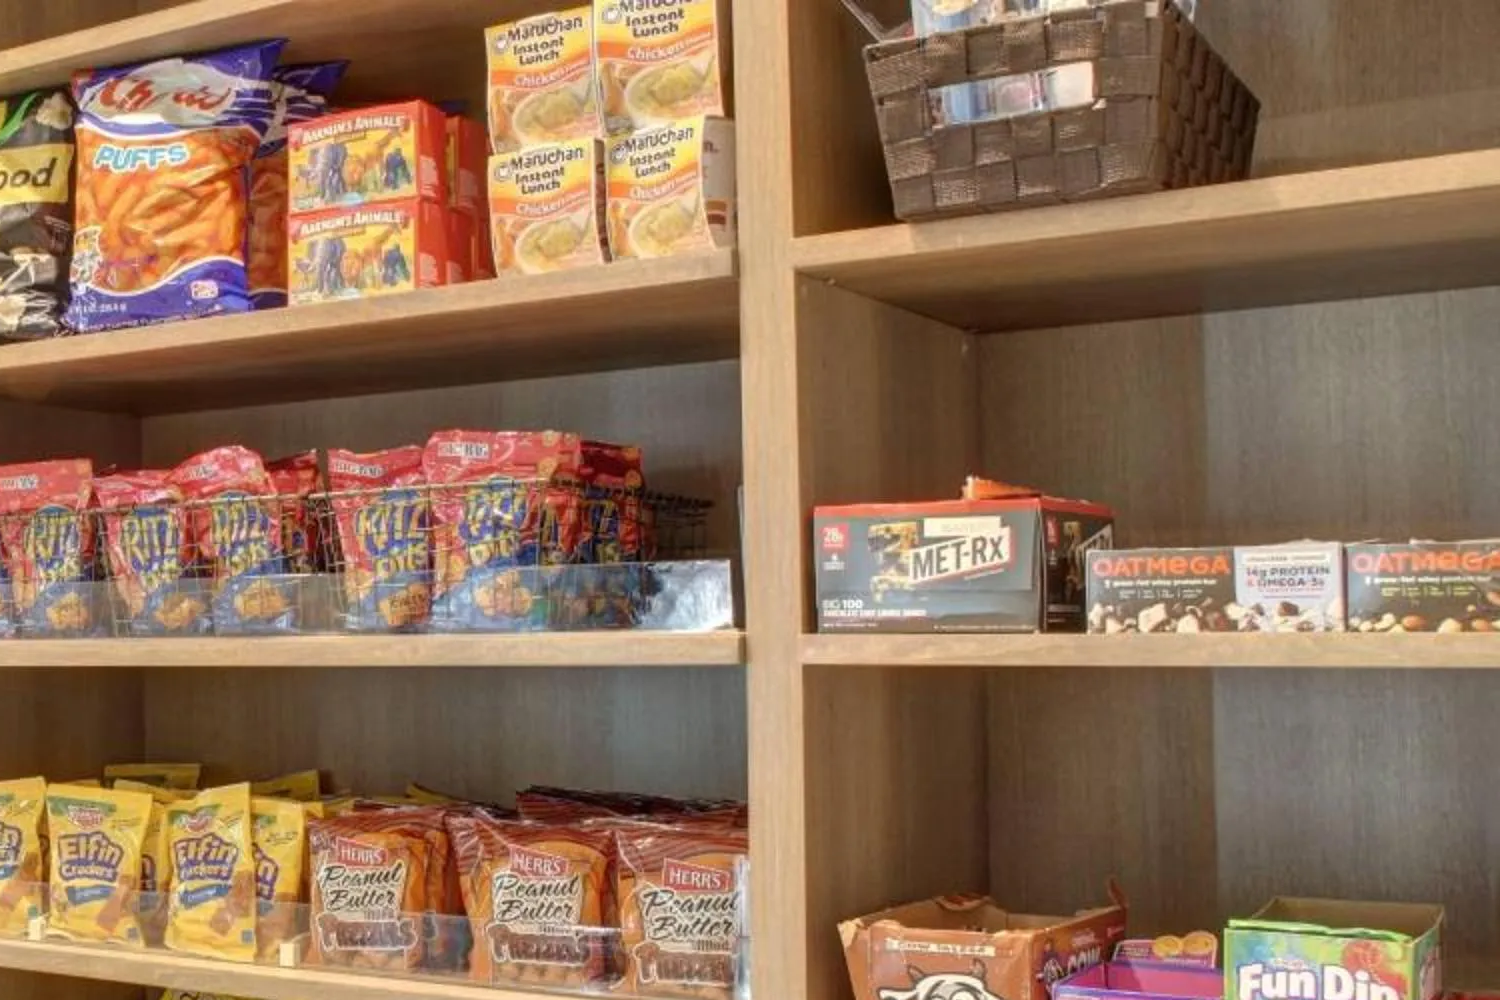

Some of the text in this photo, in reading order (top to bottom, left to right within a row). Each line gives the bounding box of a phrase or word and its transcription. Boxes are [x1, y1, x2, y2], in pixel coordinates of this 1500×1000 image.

[508, 16, 583, 42] Maruchan
[625, 10, 684, 27] Instant
[633, 22, 679, 38] Lunch
[513, 36, 564, 55] Instant
[519, 50, 560, 66] Lunch
[624, 126, 694, 152] Maruchan
[95, 144, 188, 171] PUFFS
[509, 146, 584, 169] Maruchan
[630, 149, 676, 167] Instant
[515, 167, 565, 184] Instant
[635, 162, 671, 179] Lunch
[521, 181, 560, 195] Lunch
[911, 536, 1005, 581] MET-RX
[1269, 566, 1330, 576] PROTEIN
[842, 600, 864, 609] 100
[56, 831, 124, 862] Elfin
[173, 833, 239, 866] Elfin
[322, 862, 402, 888] Peanut
[512, 851, 563, 876] HERR'S
[495, 874, 580, 899] Peanut
[668, 867, 722, 889] HERR'S
[327, 888, 396, 912] Butter
[498, 898, 575, 923] Butter
[650, 916, 735, 939] Butter
